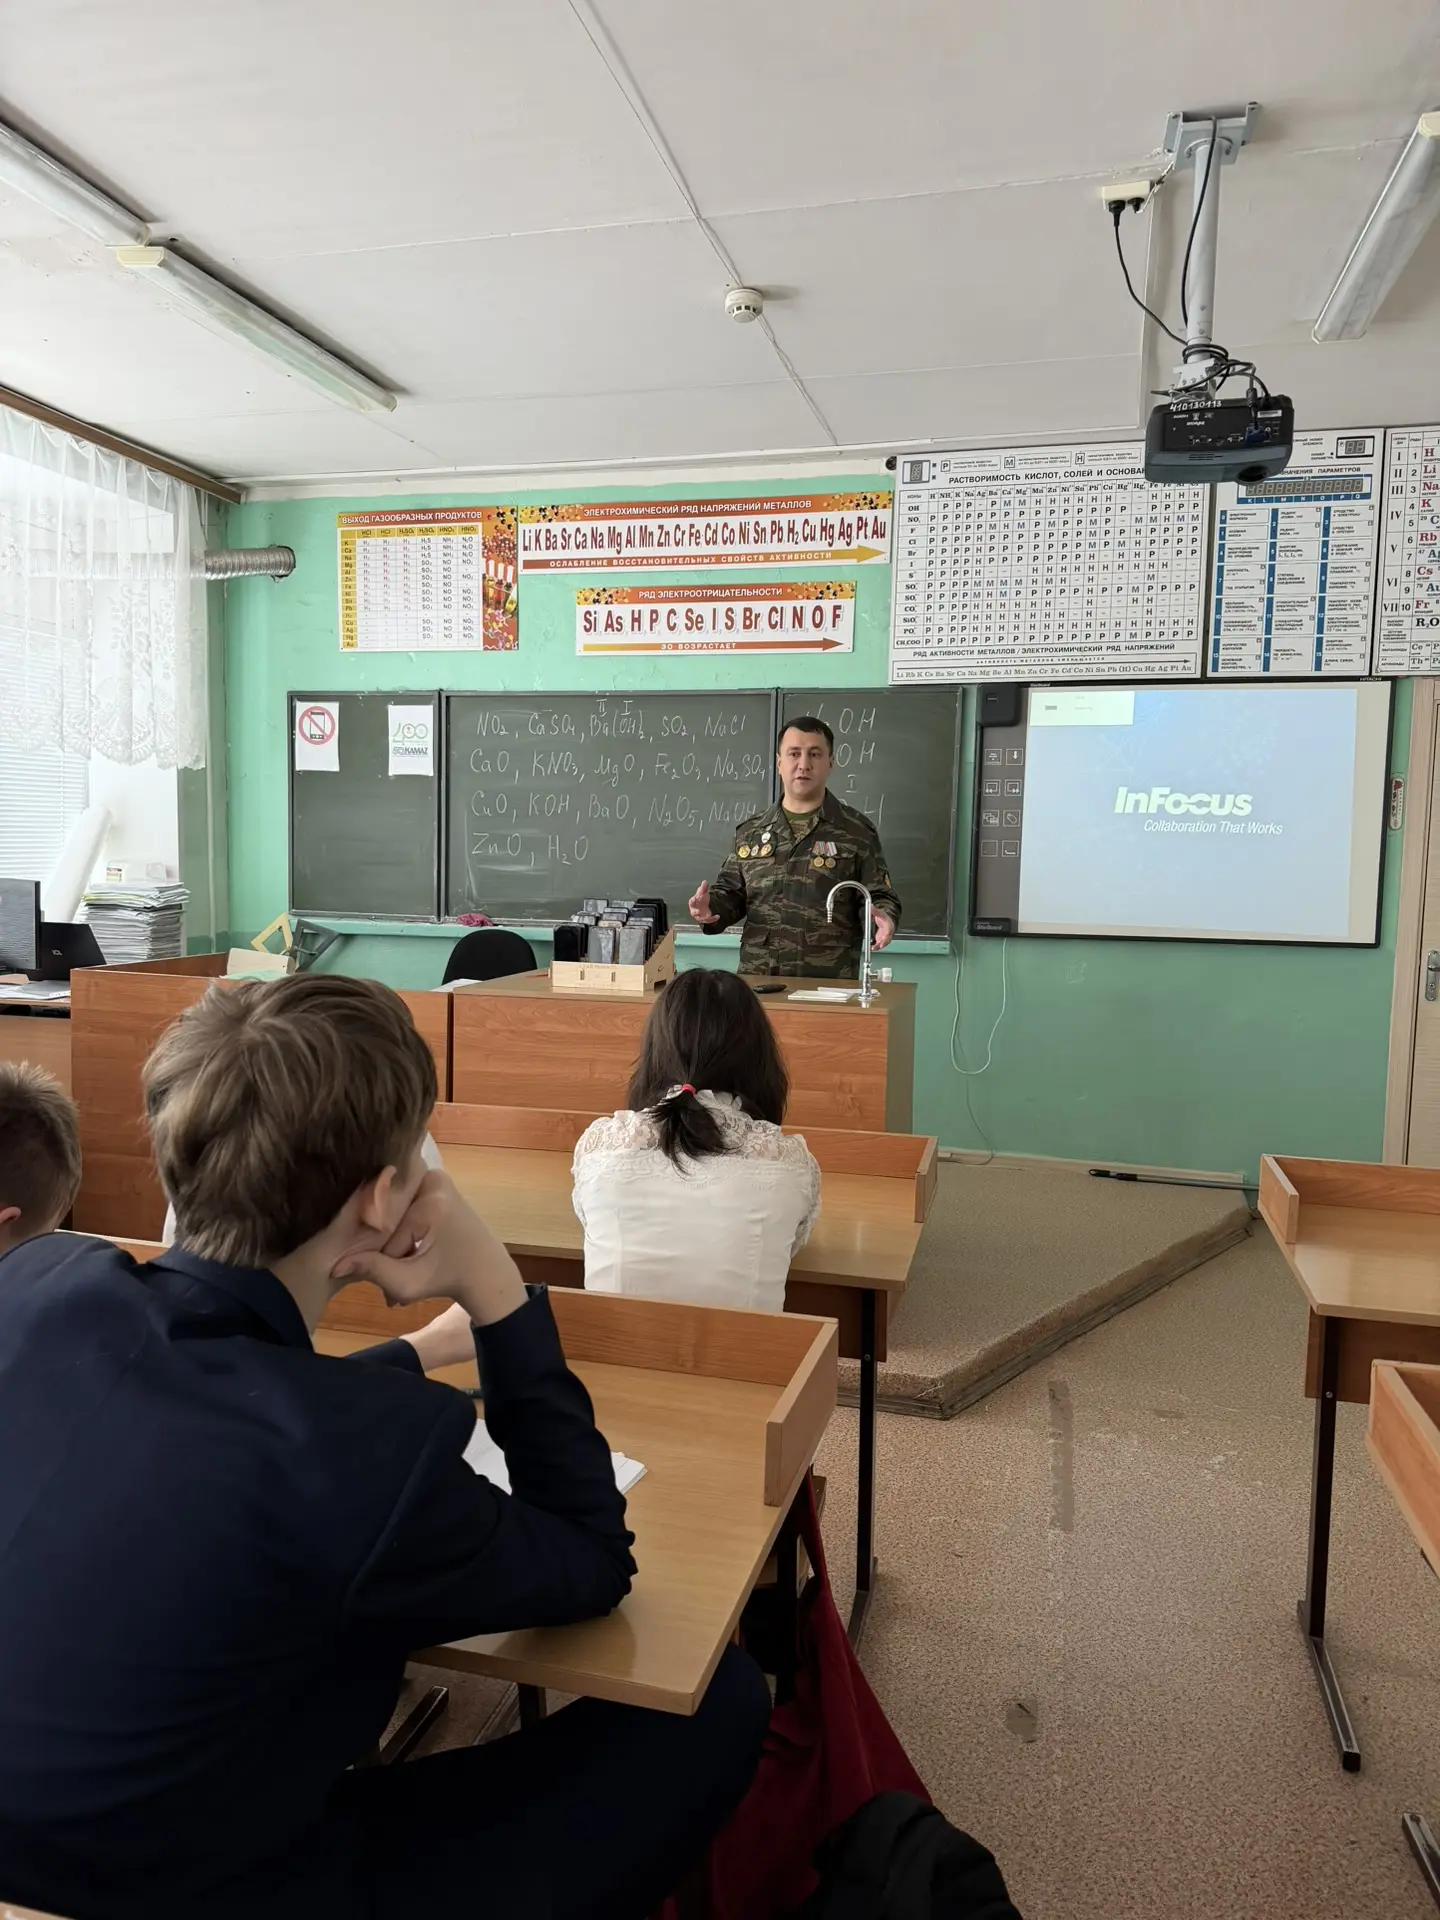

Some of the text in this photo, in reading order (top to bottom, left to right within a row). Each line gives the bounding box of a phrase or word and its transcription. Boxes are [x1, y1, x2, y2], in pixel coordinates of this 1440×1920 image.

[1424, 448, 1434, 457] H
[1318, 466, 1361, 474] ПАРАМЕТРОВ
[1424, 465, 1436, 474] Li
[949, 473, 1020, 484] РАСТВОРИМОСТЬ
[1024, 471, 1062, 480] КИСЛОТ,
[1064, 468, 1093, 478] СОЛЕЙ
[1410, 486, 1416, 494] 3
[1422, 482, 1440, 490] Na
[583, 500, 812, 517] ЭЛЕКТРОХИМИЧЕСКИЙ РЯД НАПРЯЖЕНИЙ МЕТАЛЛОВ
[1421, 499, 1432, 508] K
[342, 512, 482, 524] ВЫХОД ГАЗООБРАЗНЫХ ПРОДУКТОВ
[1430, 516, 1440, 524] C
[1408, 536, 1413, 544] 6
[1420, 533, 1437, 541] Rb
[550, 552, 832, 568] ОСЛАБЛЕНИЕ ВОССТАНОВИТЕЛЬНЫХ СВОЙСТВ АКТИВНОСТИ
[1406, 570, 1411, 578] 8
[1416, 566, 1434, 576] Cs
[638, 588, 782, 600] РЯД ЭЛЕКТРООТРИЦАТЕЛЬНОСТИ
[1404, 586, 1410, 594] 9
[1415, 600, 1430, 609] Fr
[678, 642, 737, 650] ВОЗРАСТАЕТ
[977, 648, 1016, 656] МЕТАЛЛОВ
[1022, 645, 1102, 654] ЭЛЕКТРОХИМИЧЕСКИЙ
[404, 746, 428, 755] KAMAZ
[1114, 786, 1253, 816] InFocus
[1144, 819, 1283, 835] Collaboration That Works
